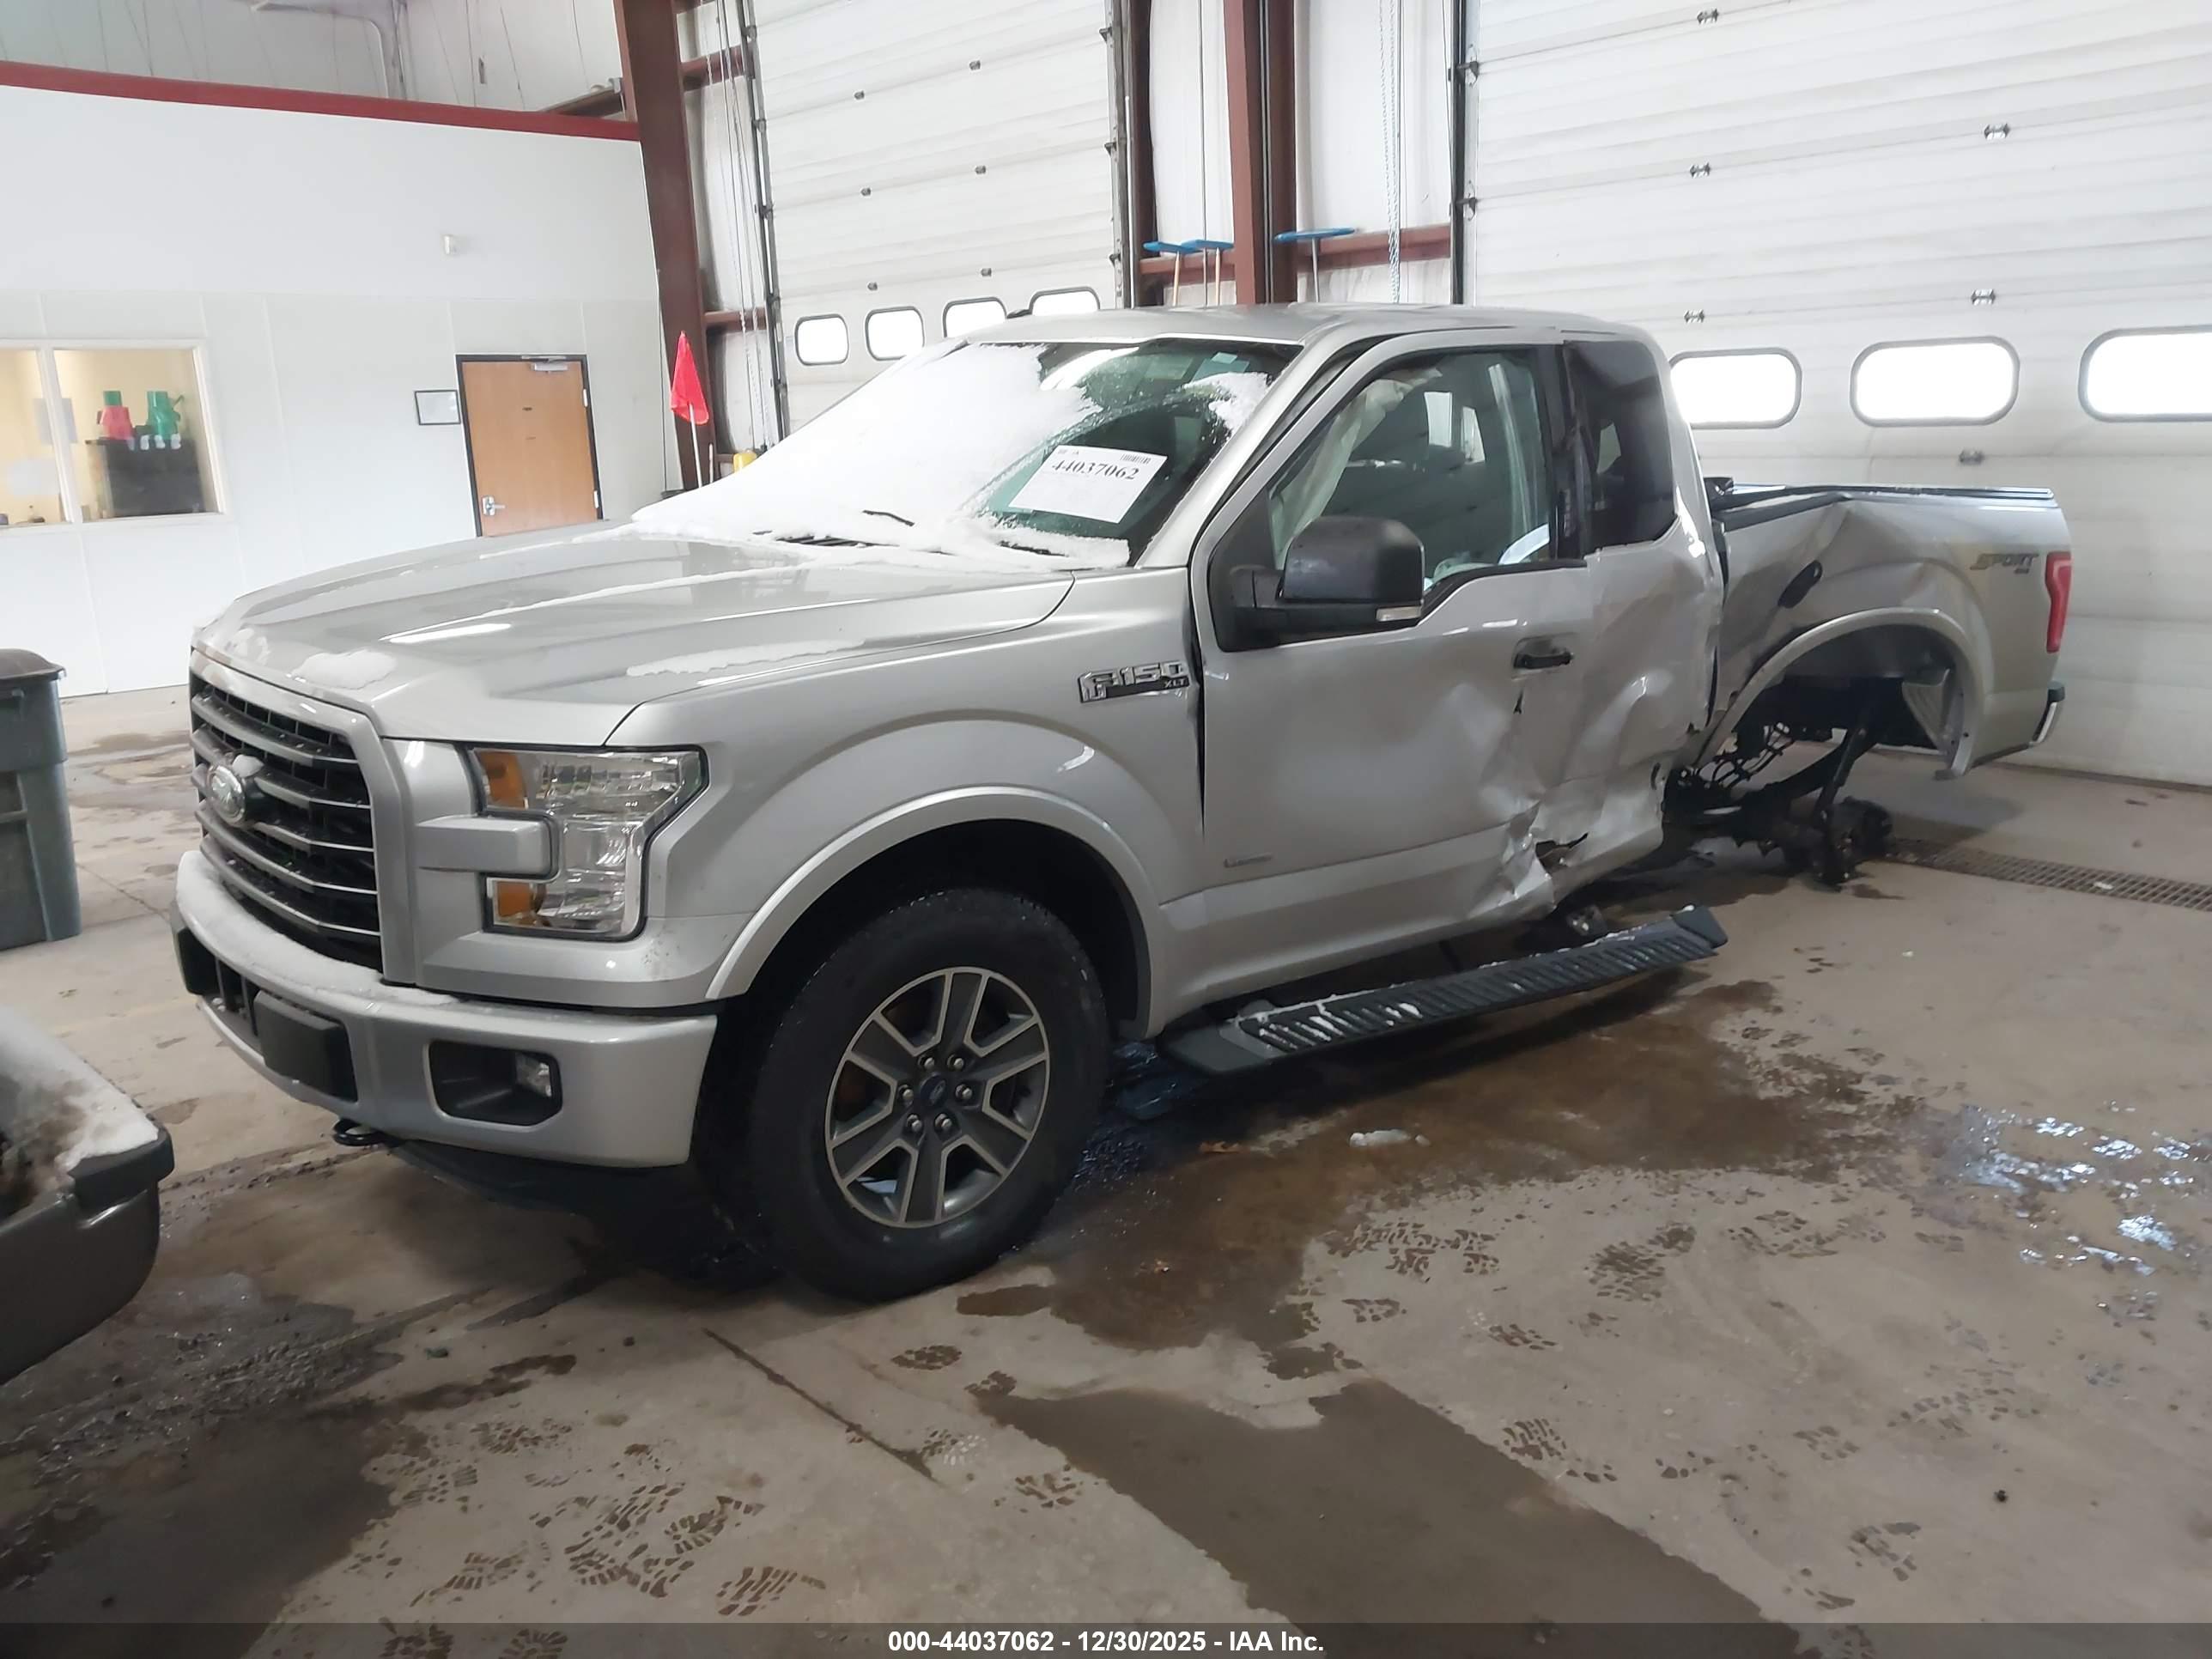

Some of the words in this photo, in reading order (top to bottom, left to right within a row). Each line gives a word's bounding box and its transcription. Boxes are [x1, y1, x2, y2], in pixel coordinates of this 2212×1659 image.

[1052, 459, 1139, 480] 44037062
[1970, 553, 2039, 570] SPORT
[1164, 678, 1187, 688] XLT
